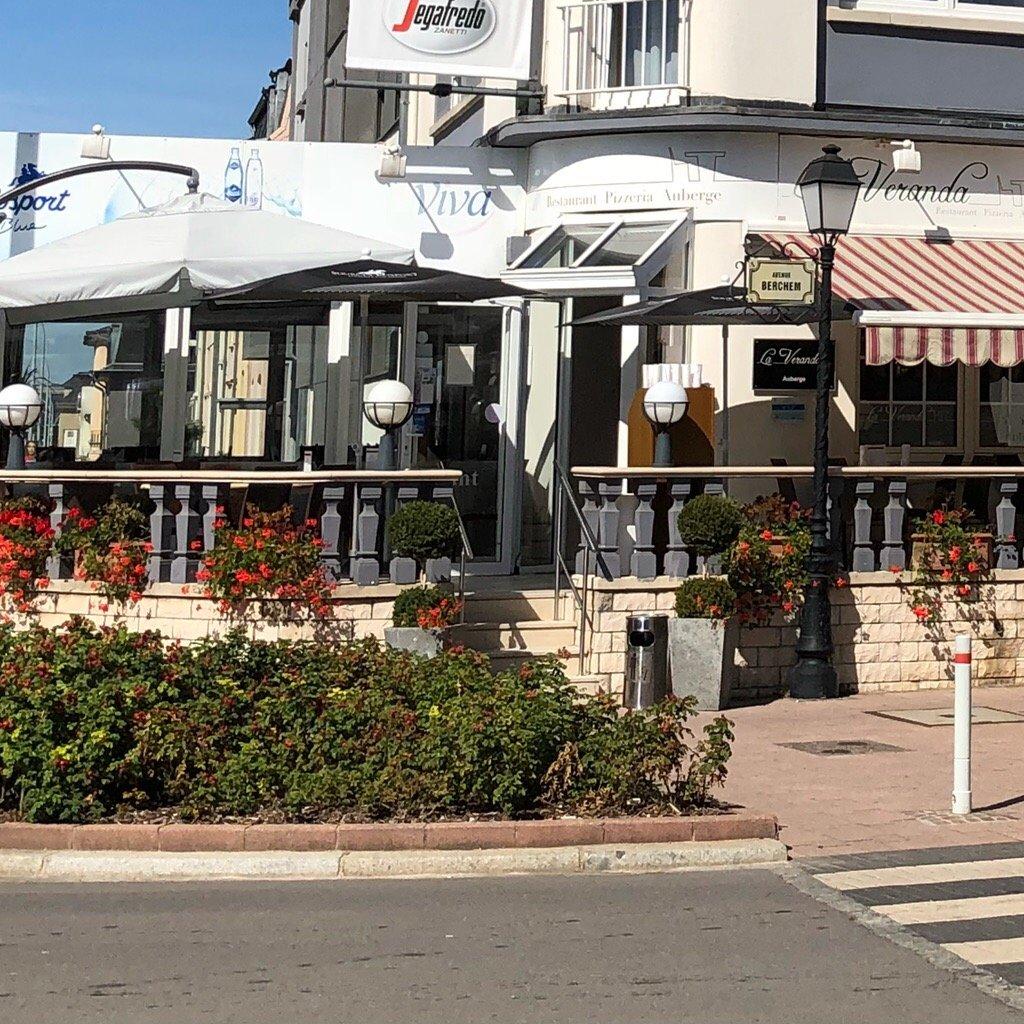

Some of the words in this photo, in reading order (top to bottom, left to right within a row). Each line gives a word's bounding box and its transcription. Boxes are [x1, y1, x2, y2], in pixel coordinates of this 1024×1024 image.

[433, 27, 467, 36] ZANETTI
[850, 156, 989, 204] Veranda
[416, 181, 492, 216] Viva
[546, 195, 597, 208] Restaurant
[605, 191, 653, 204] Pizzeria
[665, 189, 722, 205] Auberge
[761, 280, 802, 292] BERCHEM
[759, 348, 776, 366] La
[778, 348, 820, 365] Verand
